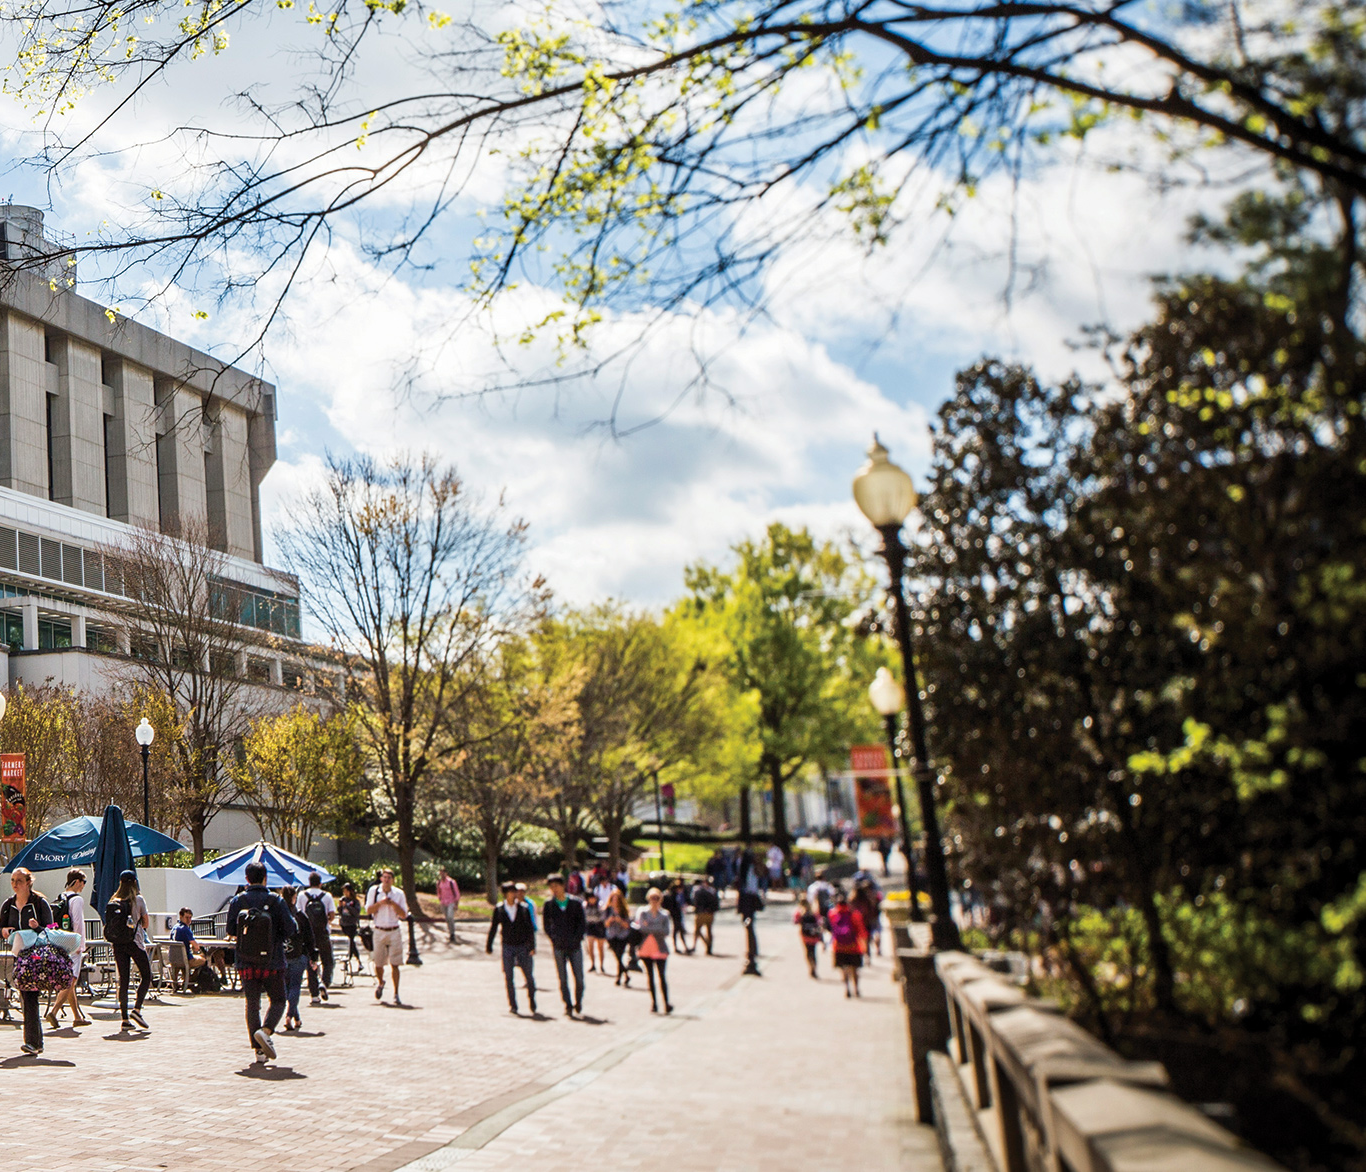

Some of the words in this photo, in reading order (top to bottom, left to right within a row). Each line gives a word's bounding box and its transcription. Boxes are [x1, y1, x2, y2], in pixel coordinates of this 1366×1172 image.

[3, 769, 23, 777] MARKET
[34, 853, 66, 862] EMORY
[72, 846, 97, 860] Dining
